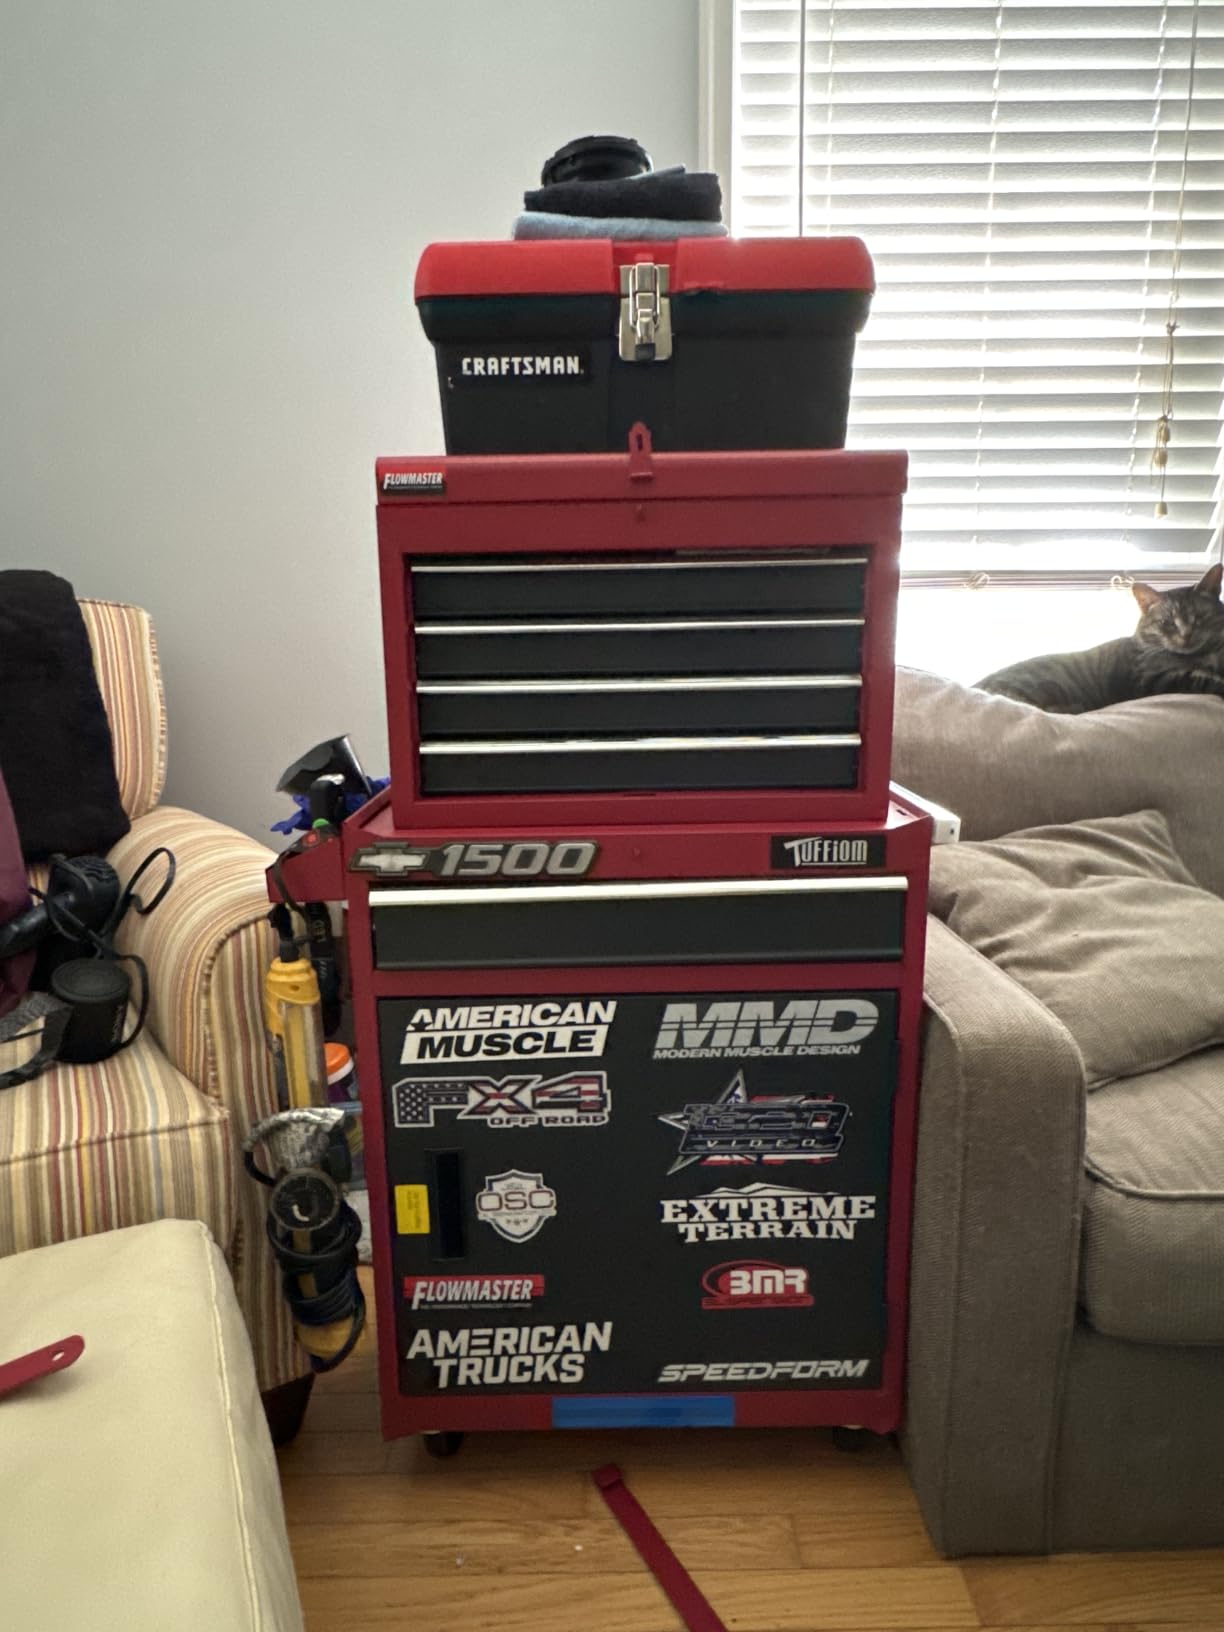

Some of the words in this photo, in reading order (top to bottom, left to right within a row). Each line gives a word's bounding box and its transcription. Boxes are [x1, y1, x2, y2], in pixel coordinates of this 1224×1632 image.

[462, 355, 580, 376] CRAFTSMAN
[383, 472, 443, 490] FLOWMASTER
[440, 842, 597, 877] 1500
[405, 1000, 617, 1032] AMERICAN
[654, 998, 879, 1049] MMD
[416, 1029, 597, 1060] MUSCLE
[652, 1046, 723, 1060] MODERN
[723, 1045, 796, 1058] MUSCLE
[797, 1044, 861, 1056] DESIGN
[392, 1070, 612, 1128] FX4
[488, 1114, 537, 1127] OFF
[544, 1114, 607, 1126] ROAD
[706, 1138, 816, 1149] VIDEO
[478, 1189, 554, 1212] OSC
[660, 1195, 876, 1223] EXTREME
[677, 1219, 857, 1243] TERRAIN
[411, 1279, 533, 1310] FLOWMASTER
[406, 1321, 613, 1359] AMERICAN
[433, 1352, 585, 1389] TRUCKS
[657, 1359, 870, 1383] SPEEDFORM
